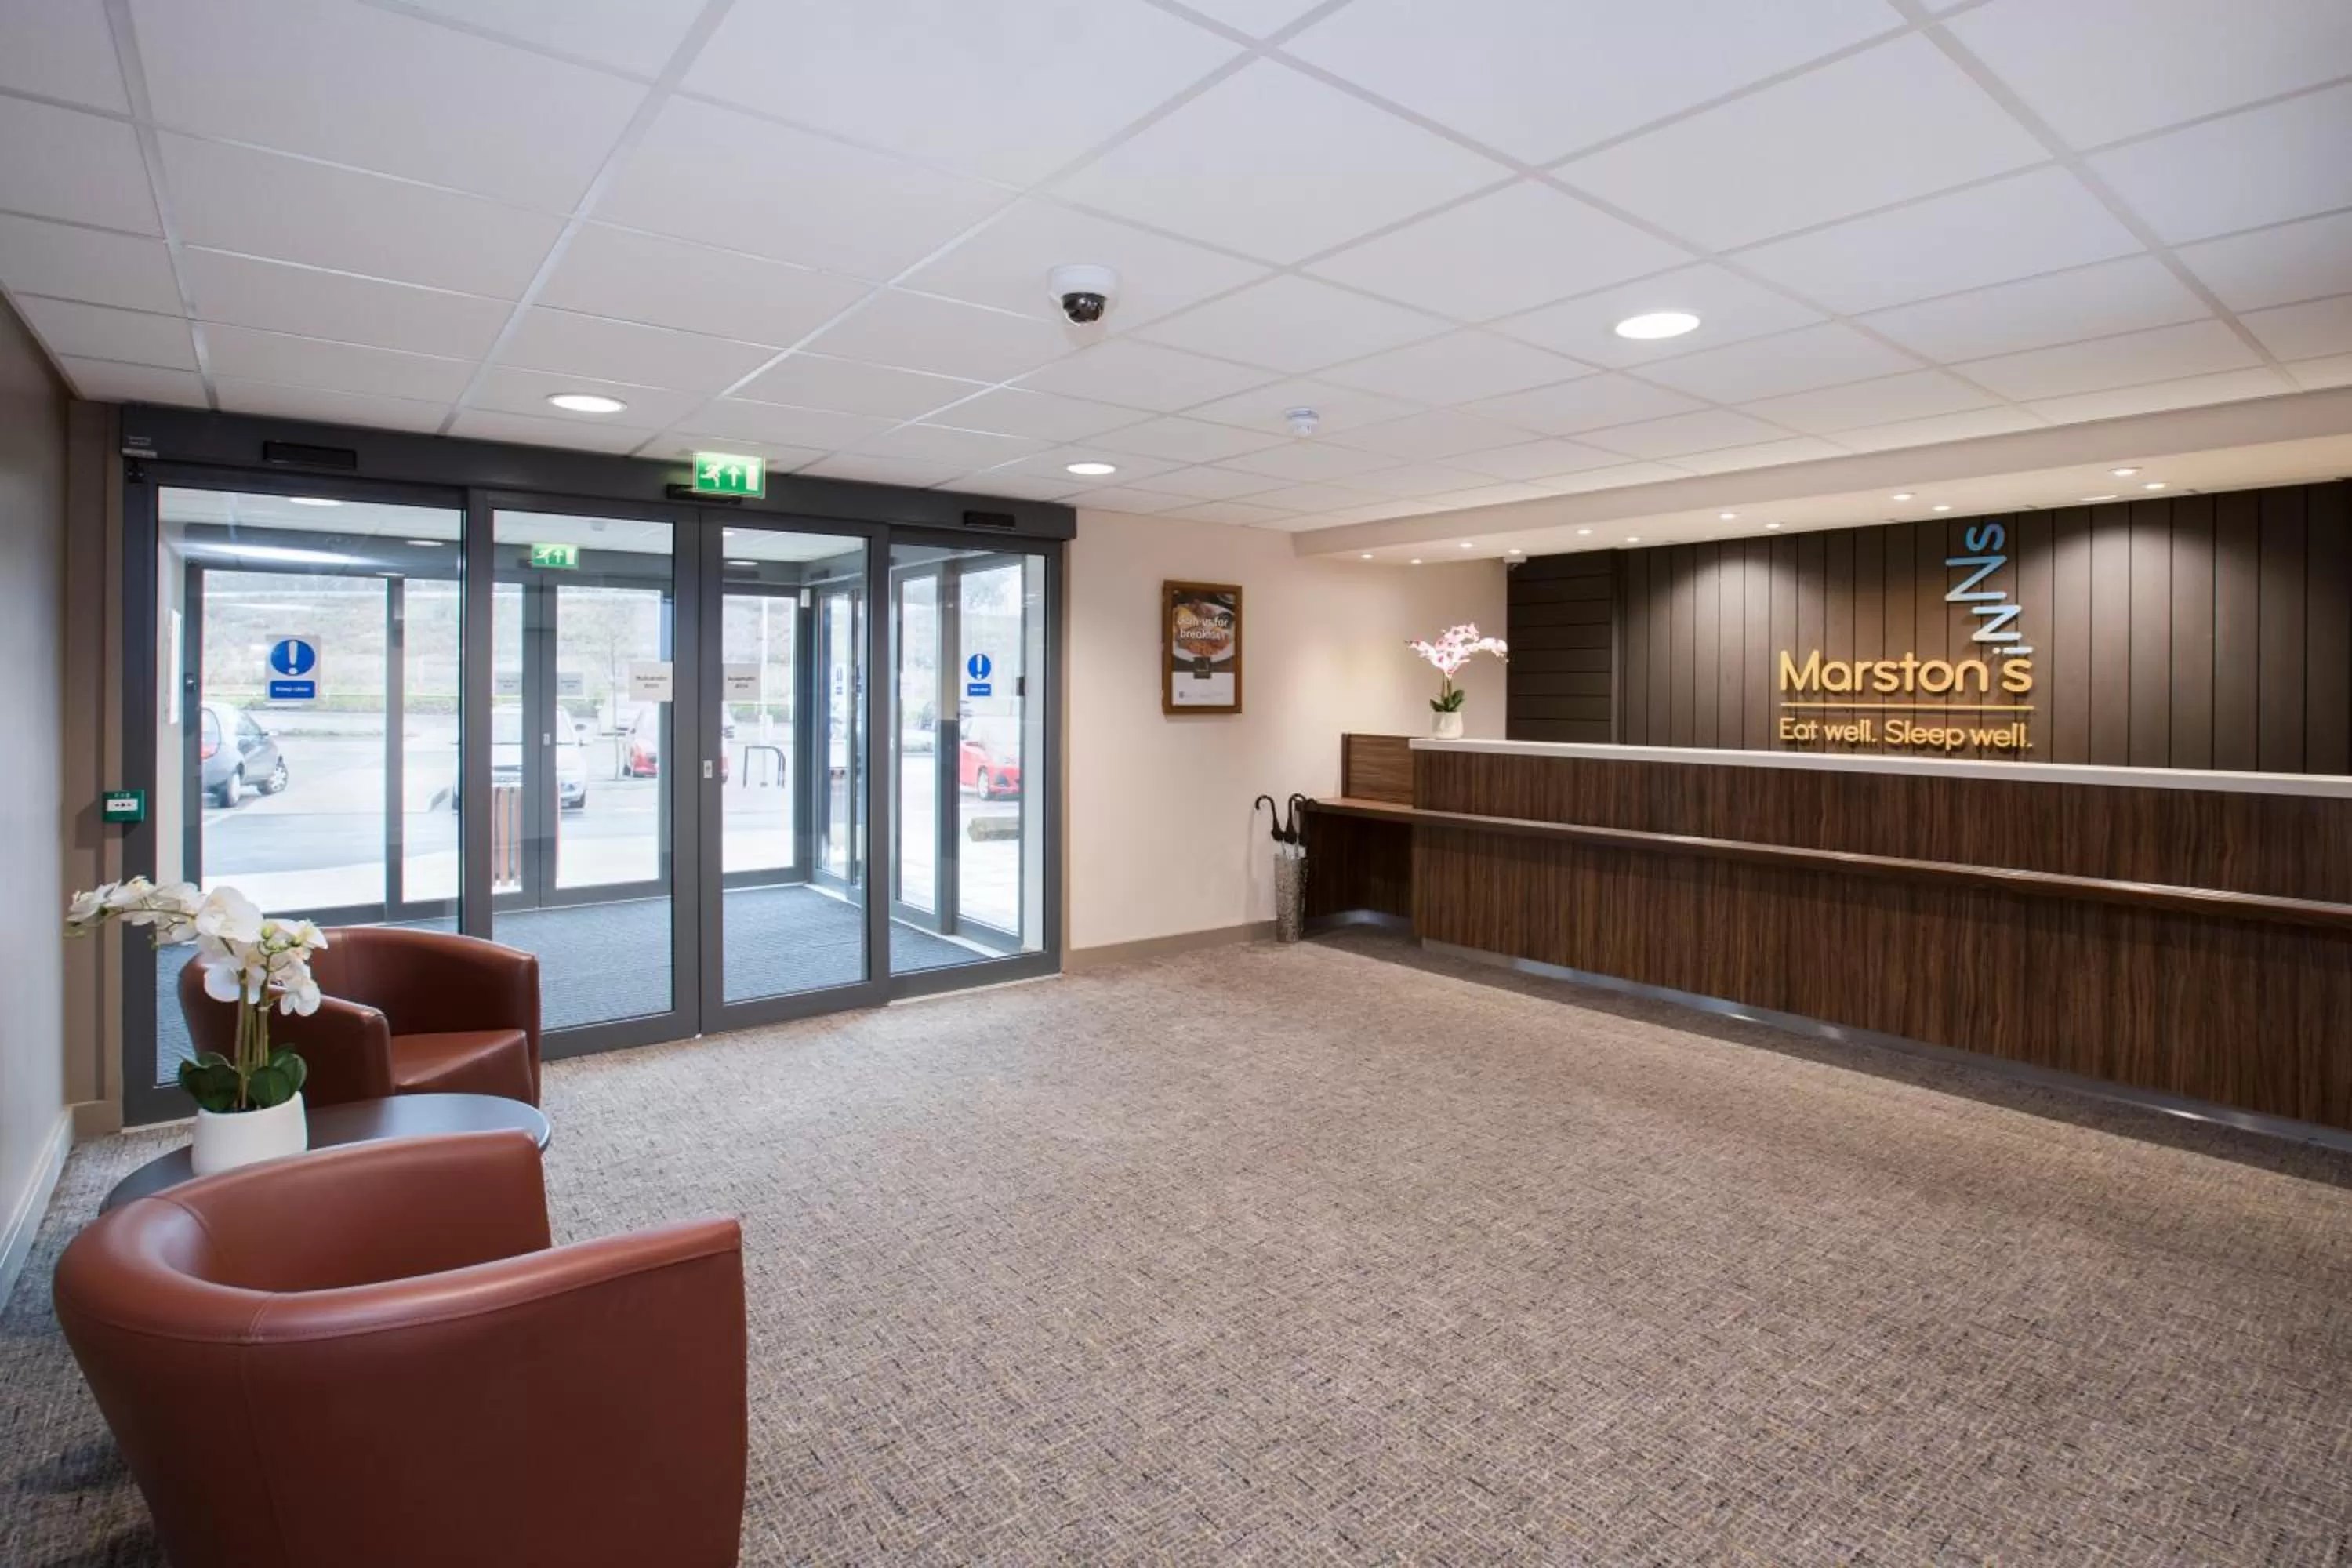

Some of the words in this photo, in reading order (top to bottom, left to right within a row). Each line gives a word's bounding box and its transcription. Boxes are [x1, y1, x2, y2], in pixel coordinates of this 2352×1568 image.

[1214, 615, 1229, 627] for
[1779, 717, 1818, 741] Eat
[1822, 719, 1878, 743] well.
[1884, 719, 1965, 750] Sleep
[1969, 722, 2034, 749] well.
